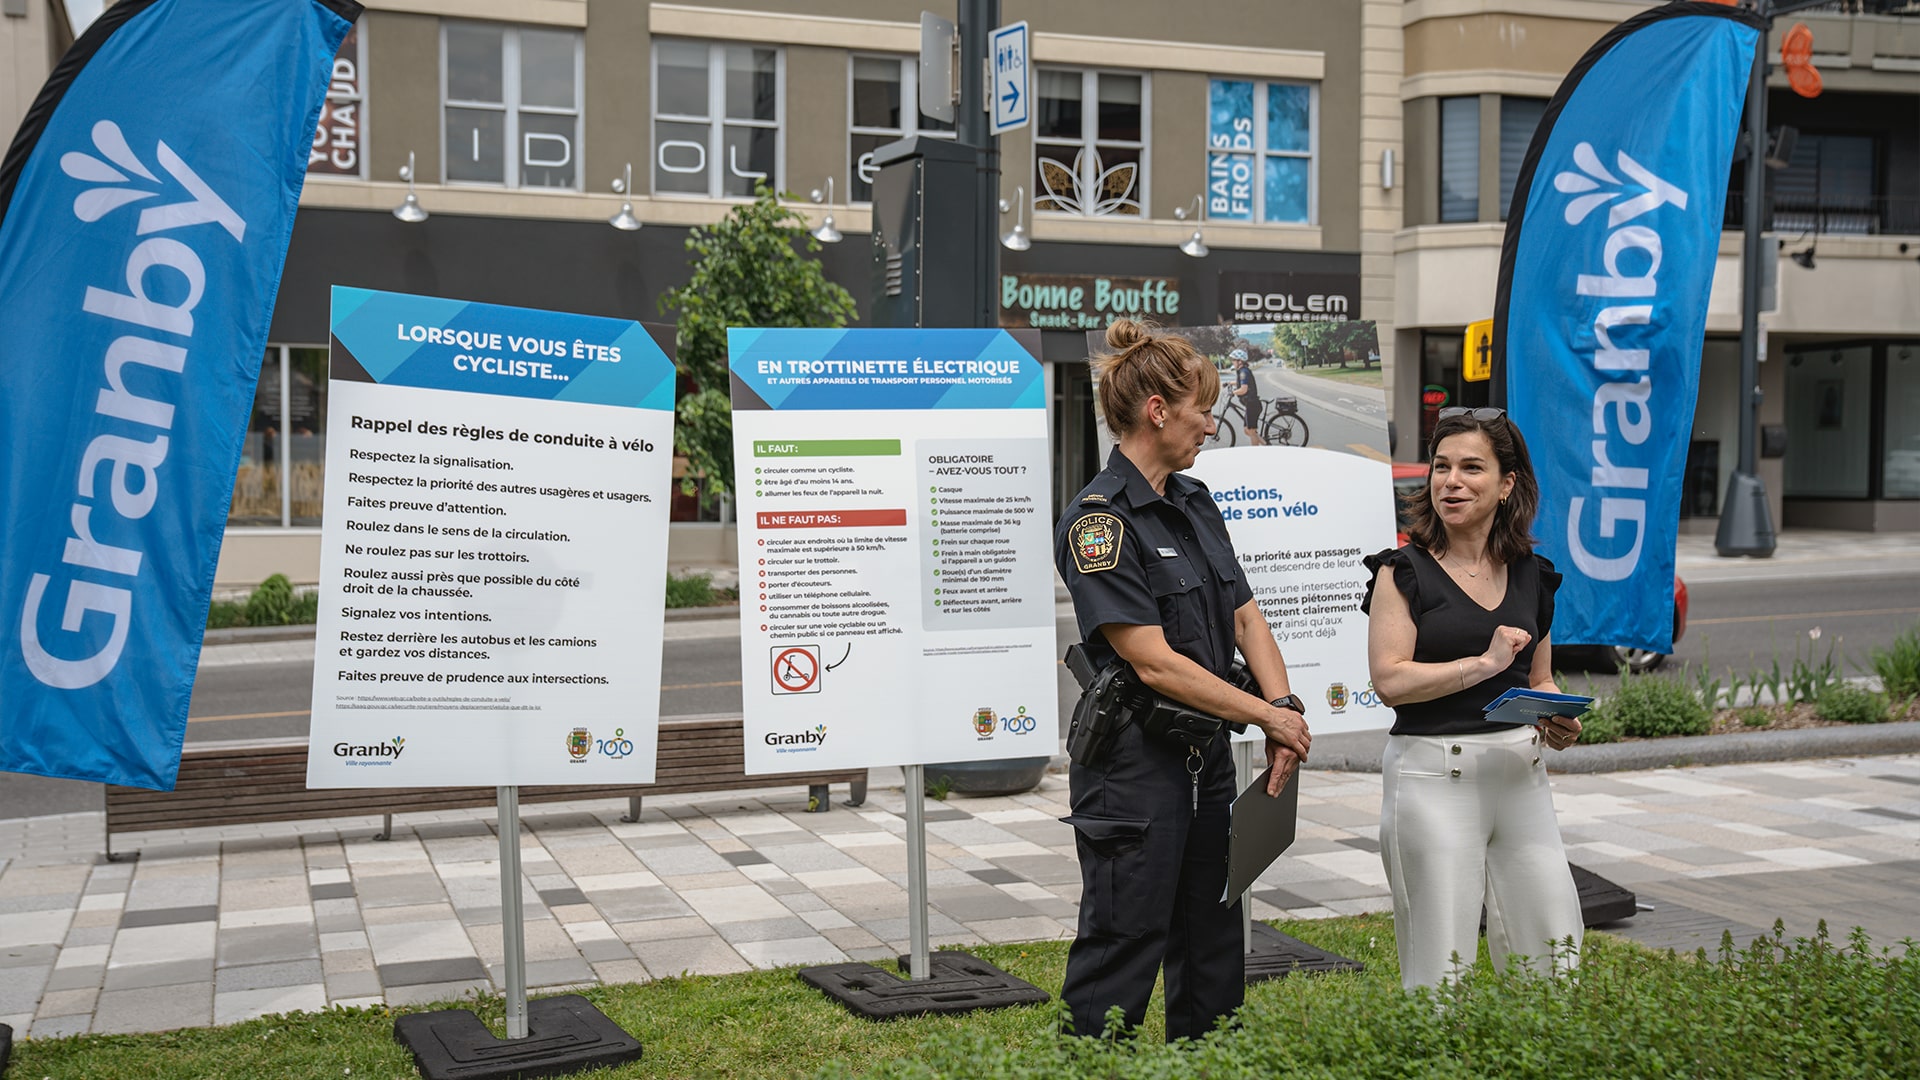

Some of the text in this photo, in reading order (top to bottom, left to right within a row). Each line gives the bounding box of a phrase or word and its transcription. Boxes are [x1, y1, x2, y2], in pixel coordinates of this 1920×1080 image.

[331, 57, 356, 170] CHAUD
[1211, 133, 1231, 214] BAINS
[1232, 117, 1252, 215] FROIDS
[1001, 275, 1180, 314] Bonne Bouffe
[1235, 292, 1348, 312] IDOLEM
[1029, 311, 1101, 328] Snack-Bar
[398, 323, 621, 362] LORSQUE VOUS ÊTES
[453, 354, 568, 380] CYCLISTE...
[757, 357, 1019, 376] EN TROTTINETTE ÉLECTRIQUE
[1567, 149, 1688, 581] Granby
[967, 375, 1012, 384] MOTORISÉS
[20, 139, 247, 690] Granby
[351, 415, 653, 452] Rappel des règles de conduite à vélo
[757, 445, 766, 453] IL
[350, 449, 513, 470] Respectez la signalisation.
[928, 455, 993, 463] OBLIGATOIRE
[936, 466, 991, 475] AVEZ-VOUS
[993, 466, 1018, 474] TOUT
[349, 472, 651, 503] Respectez la priorité des autres usagères et usagers.
[1209, 486, 1283, 502] ections,
[348, 496, 506, 515] Faites preuve d'attention.
[1222, 502, 1317, 520] de son vélo
[760, 516, 769, 524] IL
[771, 516, 786, 524] NE
[788, 515, 814, 523] FAUT
[1075, 516, 1114, 532] POLICE
[346, 520, 569, 541] Roulez dans le sens de la circulation.
[345, 544, 529, 562] Ne roulez pas sur les trottoirs.
[1242, 553, 1251, 562] la
[1254, 550, 1291, 563] priorité
[1293, 551, 1311, 559] aux
[1314, 547, 1361, 560] passages
[1083, 560, 1112, 570] GRANBY
[1244, 564, 1267, 574] ivent
[1270, 561, 1320, 572] descendre
[1322, 560, 1335, 568] de
[1337, 559, 1358, 567] leur
[344, 568, 579, 587] Roulez aussi près que possible du côté
[343, 583, 472, 597] droit de la chaussée.
[1253, 580, 1361, 594] dans une intersection,
[1256, 598, 1299, 606] rsonnes
[1301, 593, 1352, 606] piétonnes
[341, 606, 491, 621] Signalez vos intentions.
[1261, 603, 1358, 617] ifestent clairement
[1285, 617, 1307, 628] ainsi
[1309, 616, 1342, 628] qu'aux
[340, 631, 596, 646] Restez derrière les autobus et les camions
[1277, 628, 1336, 642] s'y sont déjà
[339, 647, 352, 656] et
[356, 647, 400, 658] gardez
[428, 647, 489, 659] distances.
[338, 670, 376, 680] Faites
[380, 673, 423, 683] preuve
[427, 672, 442, 681] de
[446, 672, 504, 684] prudence
[532, 673, 608, 684] intersections.
[765, 730, 827, 745] Granby
[333, 741, 404, 760] Granby
